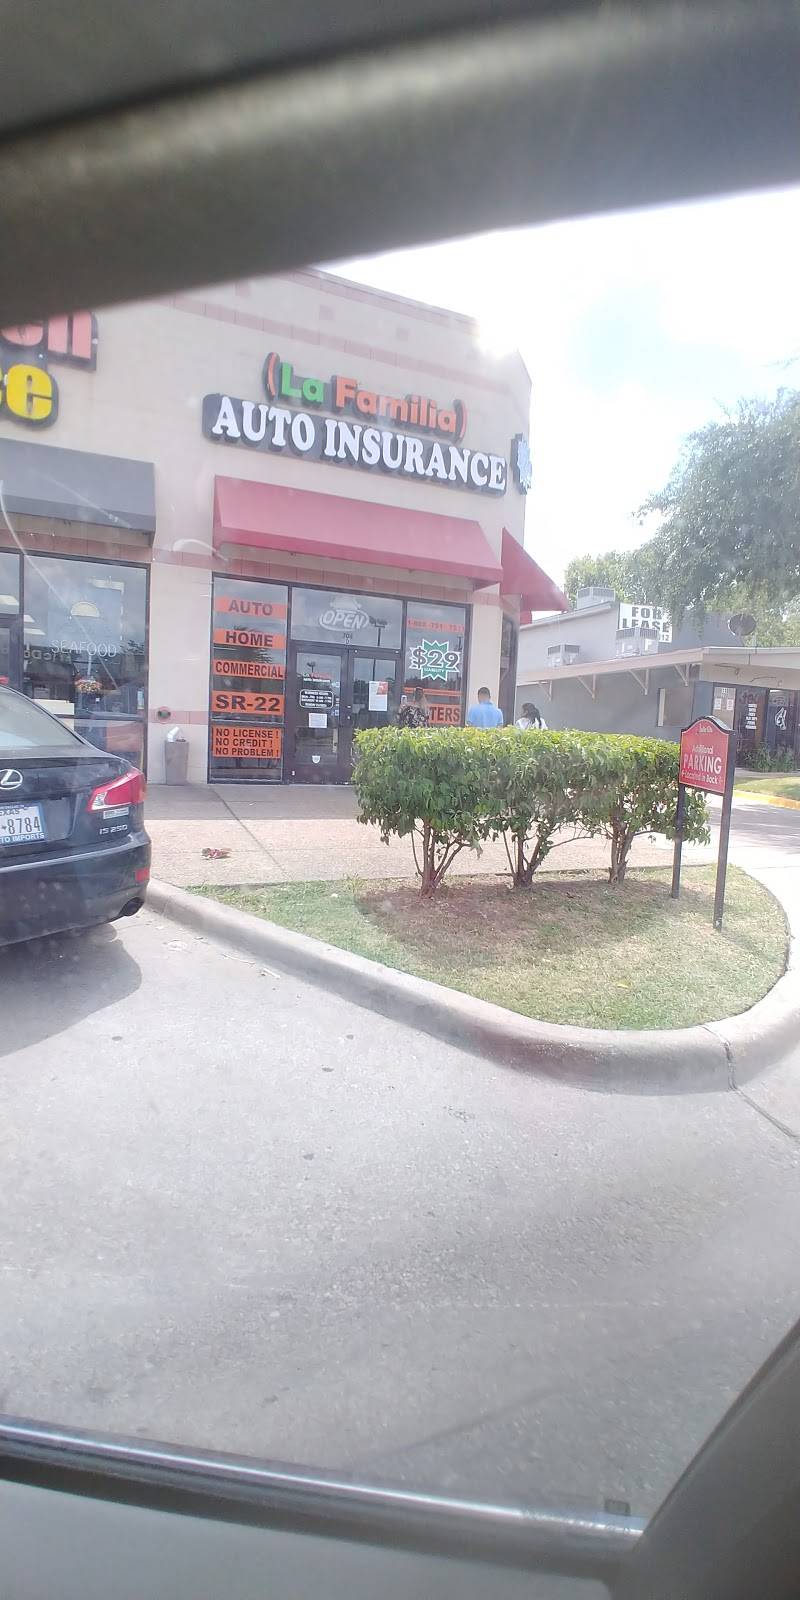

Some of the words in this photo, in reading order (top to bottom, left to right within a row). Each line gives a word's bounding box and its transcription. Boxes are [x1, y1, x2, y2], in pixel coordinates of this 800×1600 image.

[336, 375, 467, 439] Familia)
[212, 396, 315, 450] AUTO
[324, 419, 506, 490] INSURANCE
[228, 600, 273, 616] AUTO
[631, 606, 662, 619] FOR
[323, 610, 365, 629] OPEN
[225, 631, 273, 647] HOME
[51, 639, 117, 657] SEAFOOD
[411, 646, 460, 669] $29
[215, 661, 283, 678] COMMERCIAL
[215, 694, 280, 711] SR-22
[429, 706, 461, 722] TERS
[216, 728, 229, 737] NO
[233, 729, 273, 739] LICENSE
[216, 738, 229, 746] NO
[232, 738, 268, 748] CREDIT
[215, 747, 229, 755] NO
[231, 747, 274, 757] PROBLEM
[683, 753, 722, 775] PARKING
[99, 827, 109, 835] IS
[110, 824, 128, 834] 250
